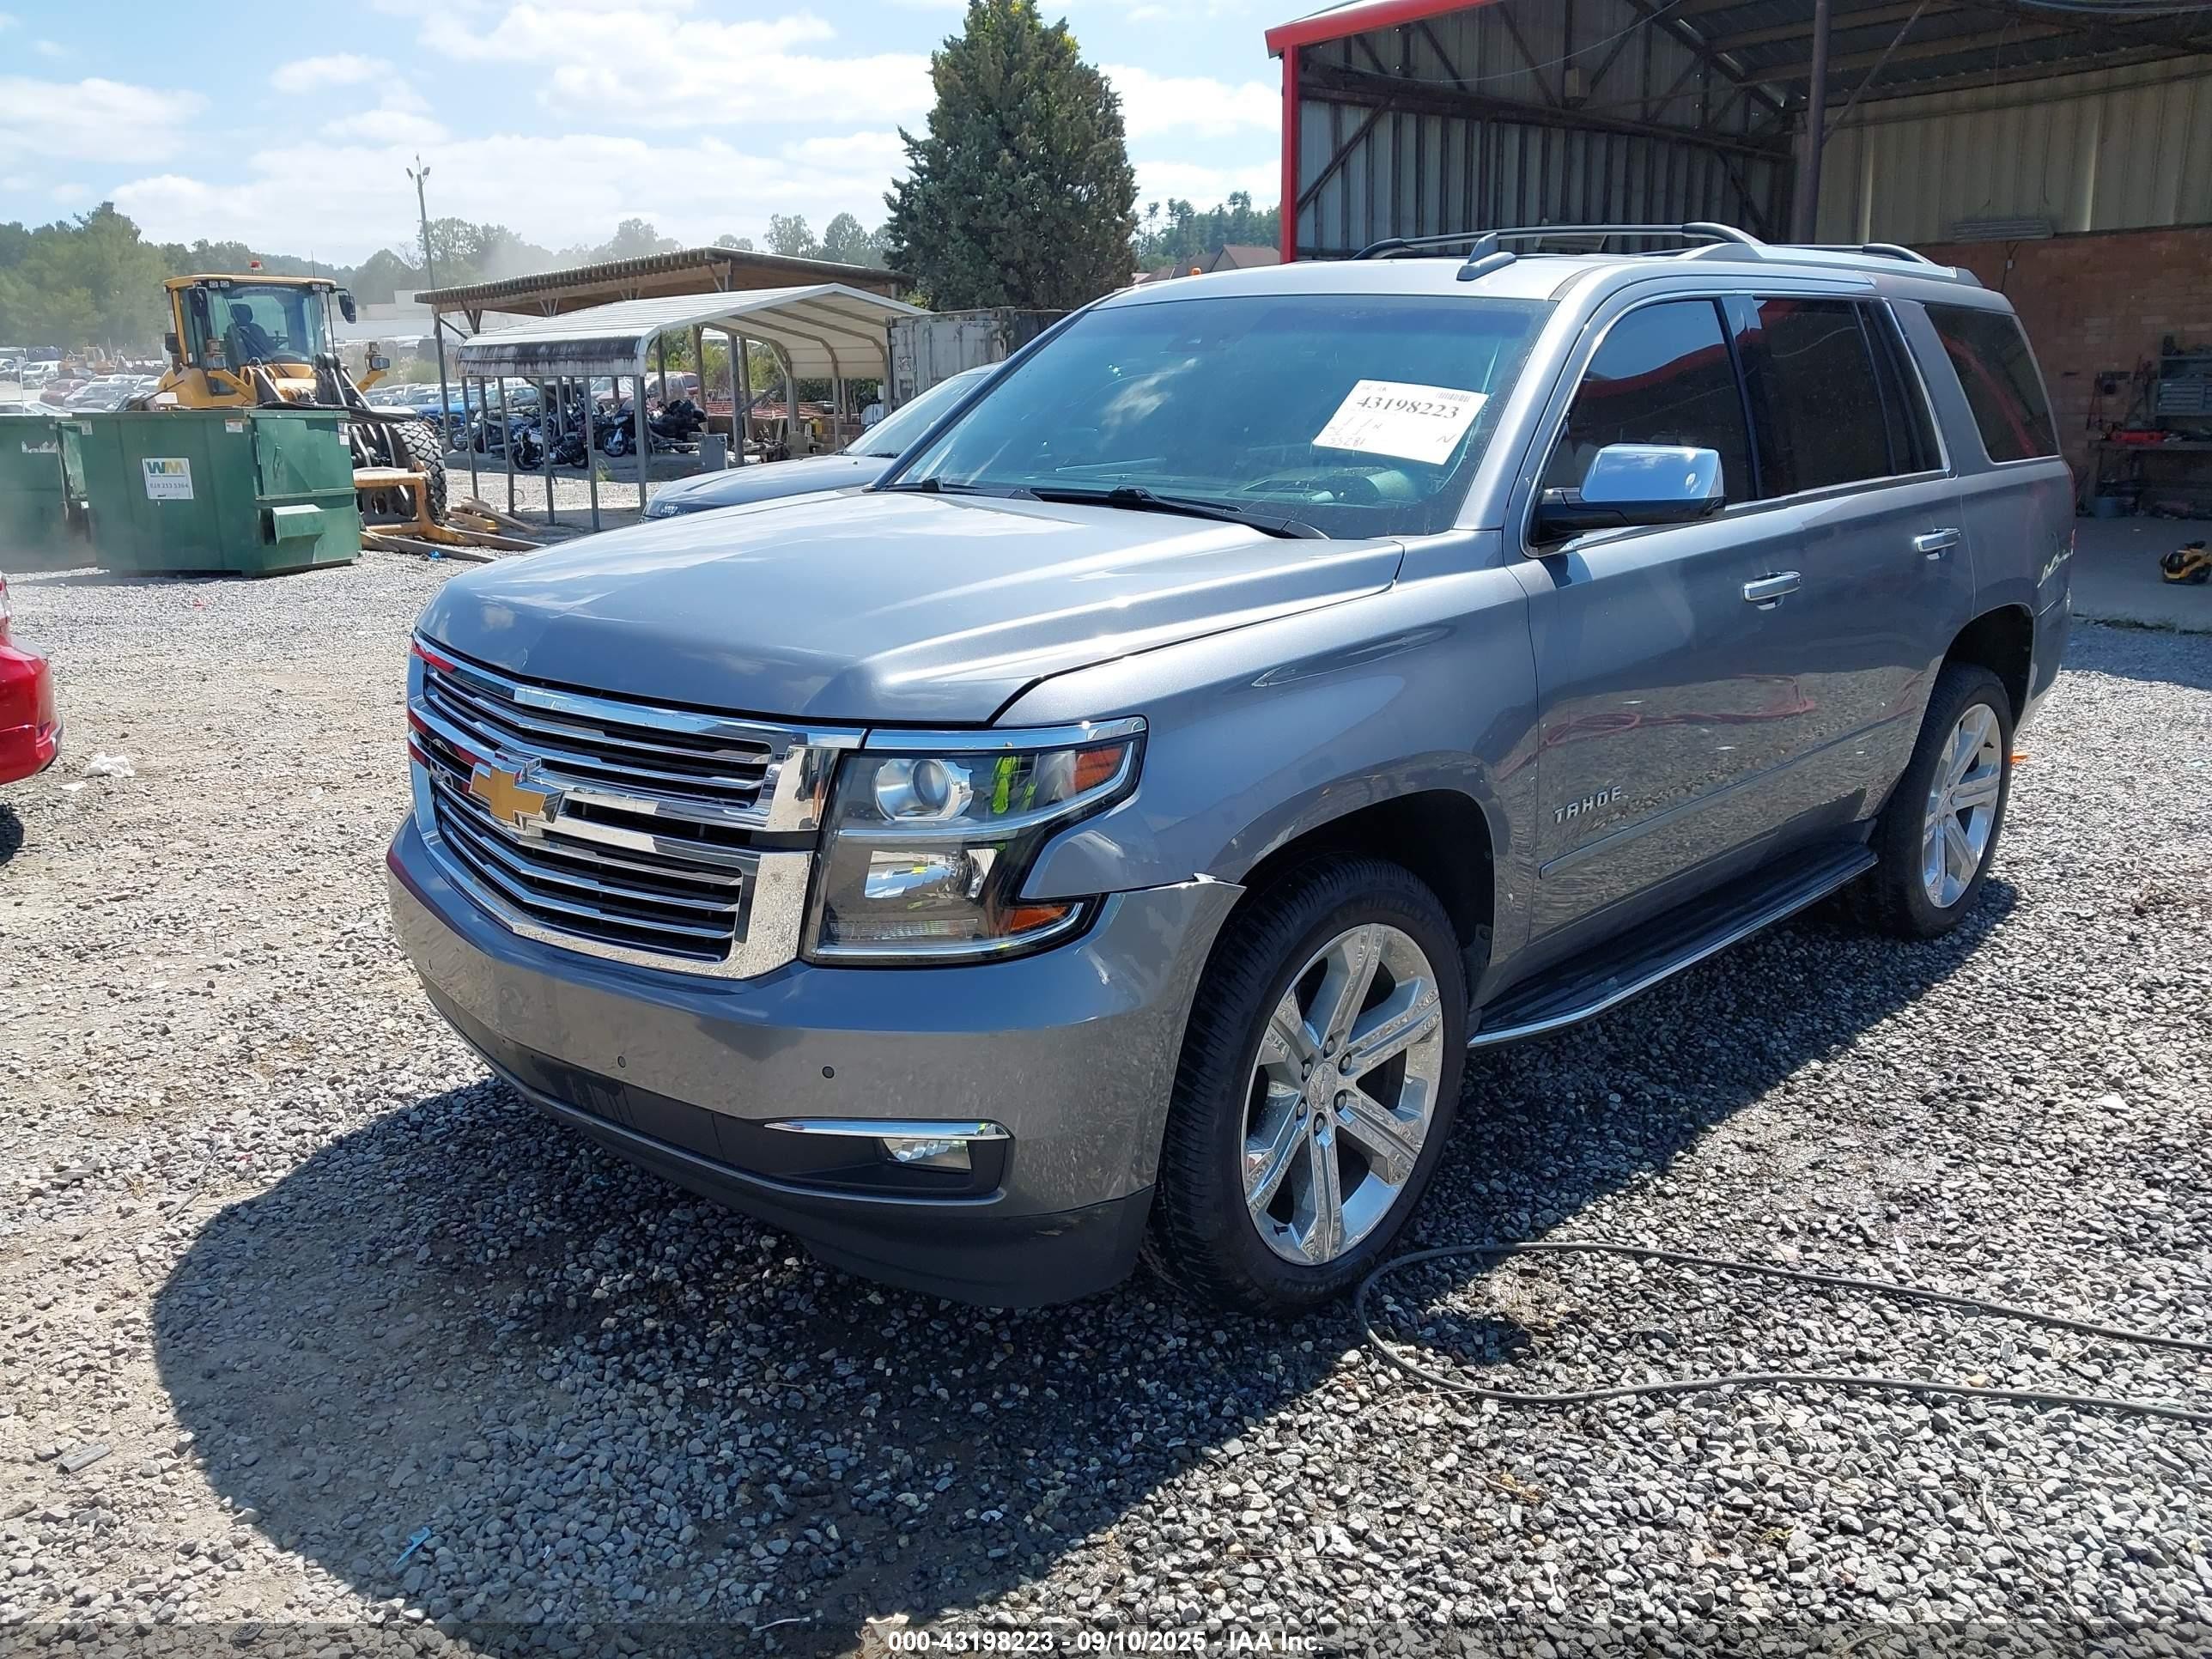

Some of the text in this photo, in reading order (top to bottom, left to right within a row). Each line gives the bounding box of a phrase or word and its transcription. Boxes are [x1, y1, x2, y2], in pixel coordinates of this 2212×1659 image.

[1356, 395, 1460, 419] 43198223
[146, 461, 184, 474] WM
[1553, 785, 1621, 824] TAHOE
